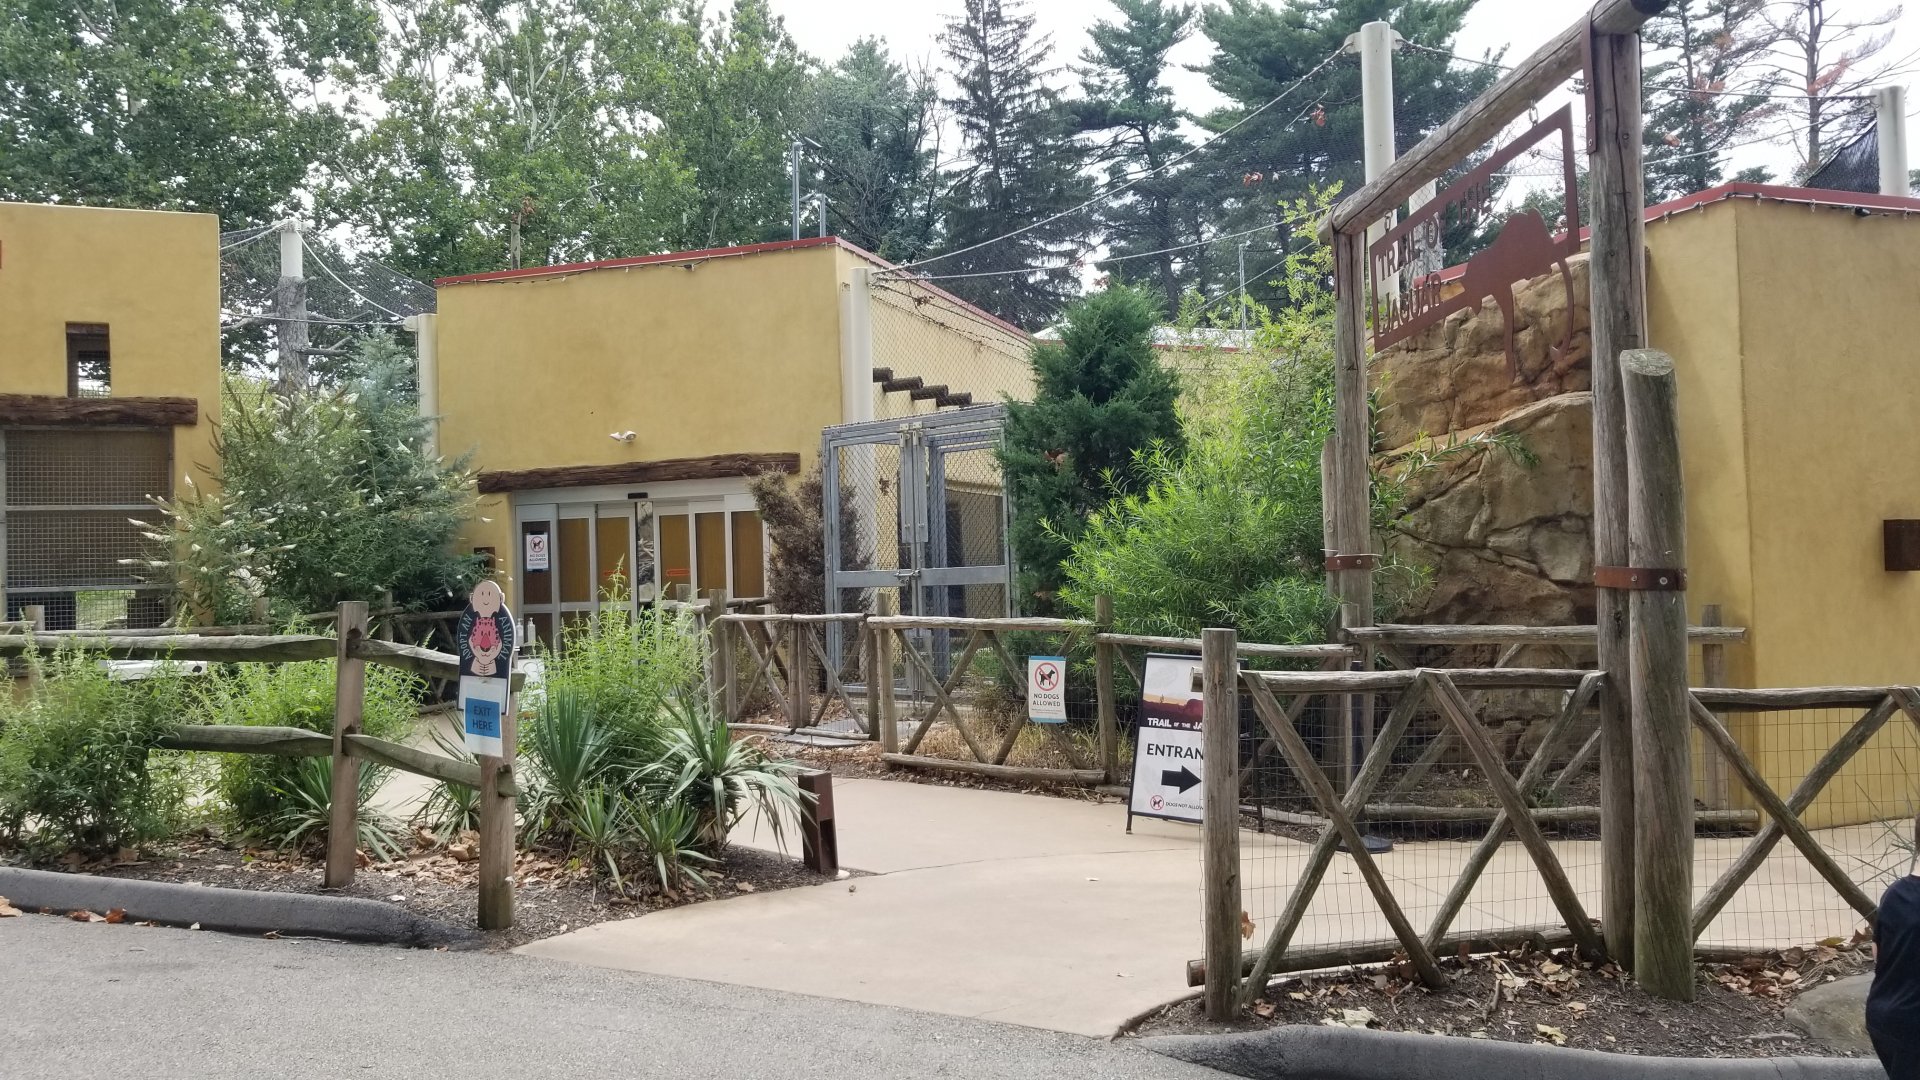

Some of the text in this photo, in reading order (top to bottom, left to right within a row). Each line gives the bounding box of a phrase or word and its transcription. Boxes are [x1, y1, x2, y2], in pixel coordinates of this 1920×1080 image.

[1376, 224, 1421, 282] TRAIL
[1378, 273, 1441, 337] JAGUAR
[460, 613, 512, 660] ADOPT AN ANIMAL
[473, 705, 491, 717] EXIT
[472, 719, 494, 731] HERE
[1147, 717, 1172, 728] TRAIL
[1146, 742, 1204, 760] ENTRAN
